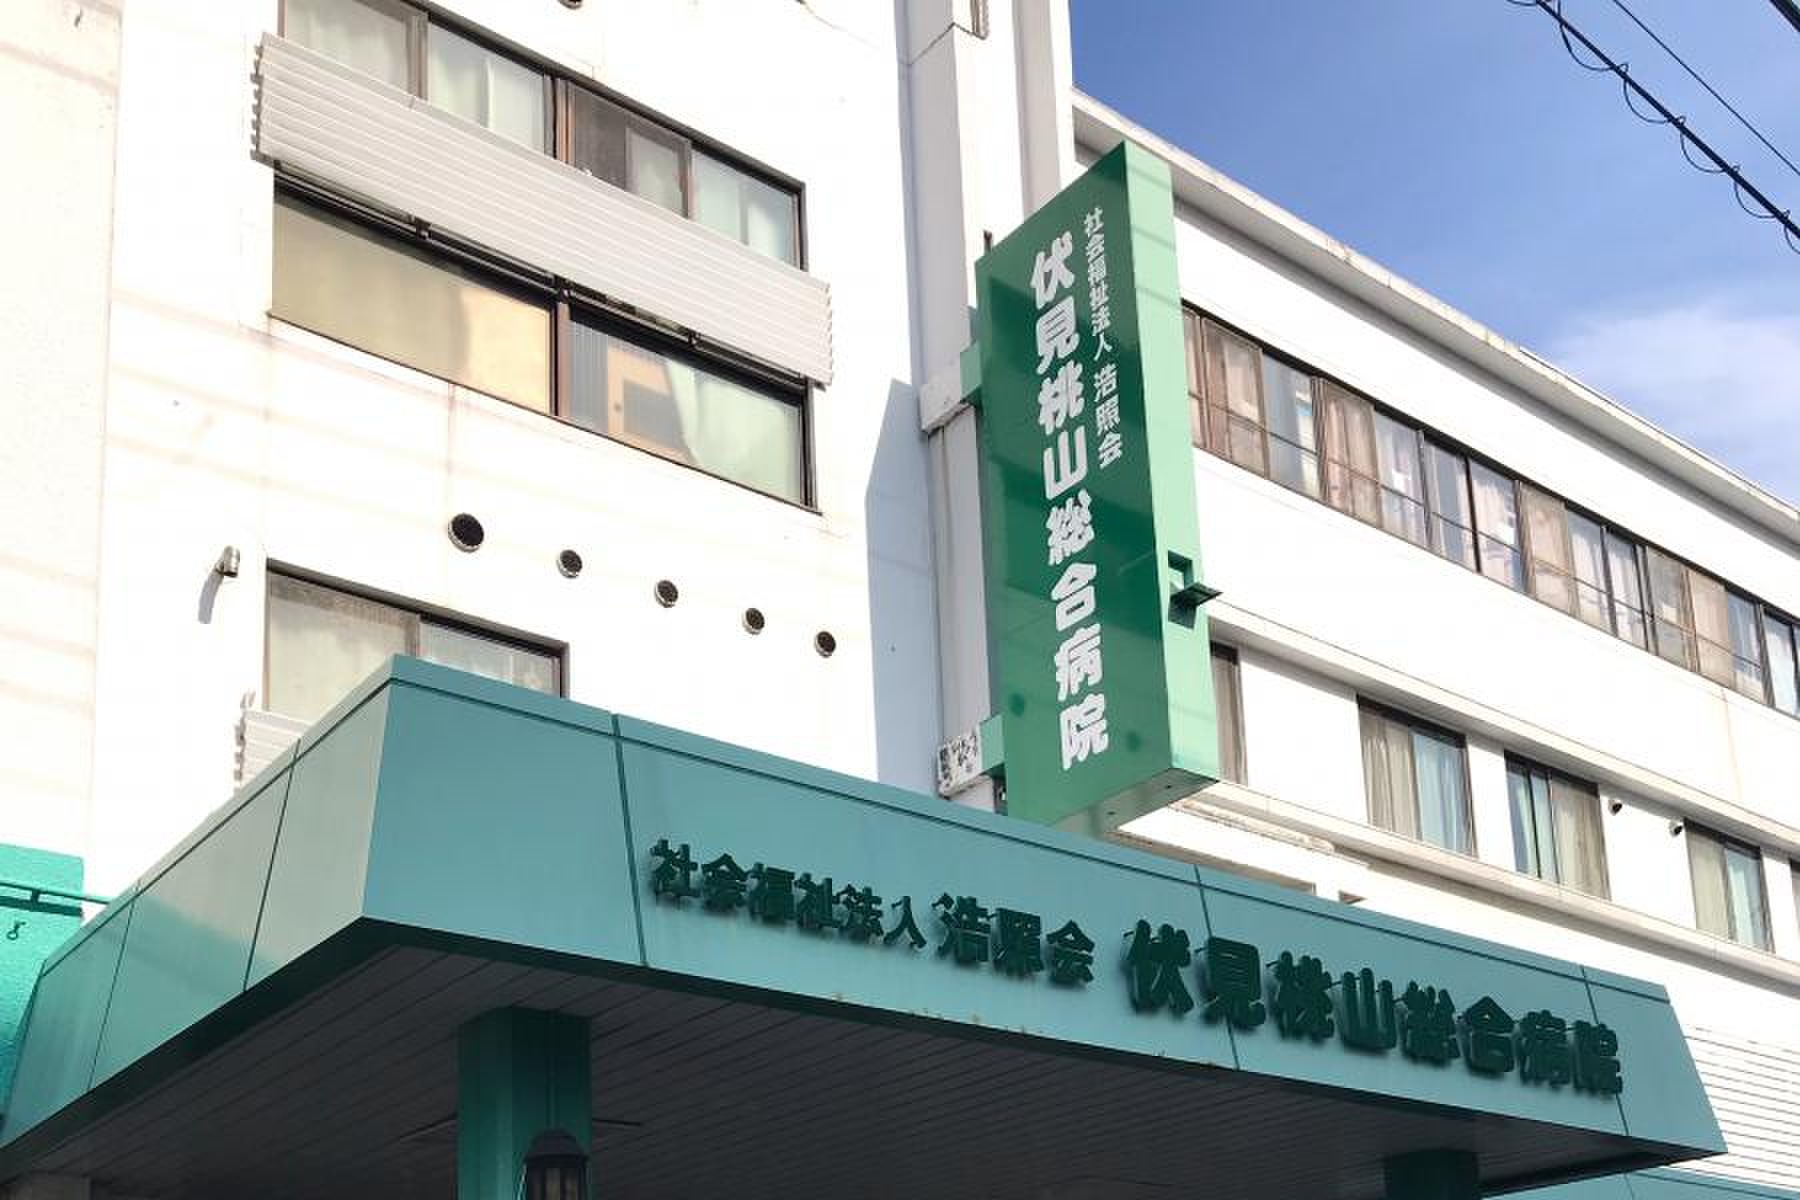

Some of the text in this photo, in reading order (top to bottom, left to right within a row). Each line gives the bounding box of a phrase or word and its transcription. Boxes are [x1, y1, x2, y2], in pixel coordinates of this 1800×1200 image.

[1083, 205, 1124, 469] 社会福祉法人 浩照会
[1029, 229, 1110, 770] 伏見桃山総合病院
[650, 838, 1624, 1097] 社会福祉法人 浩照会 伏見桃山総合病院
